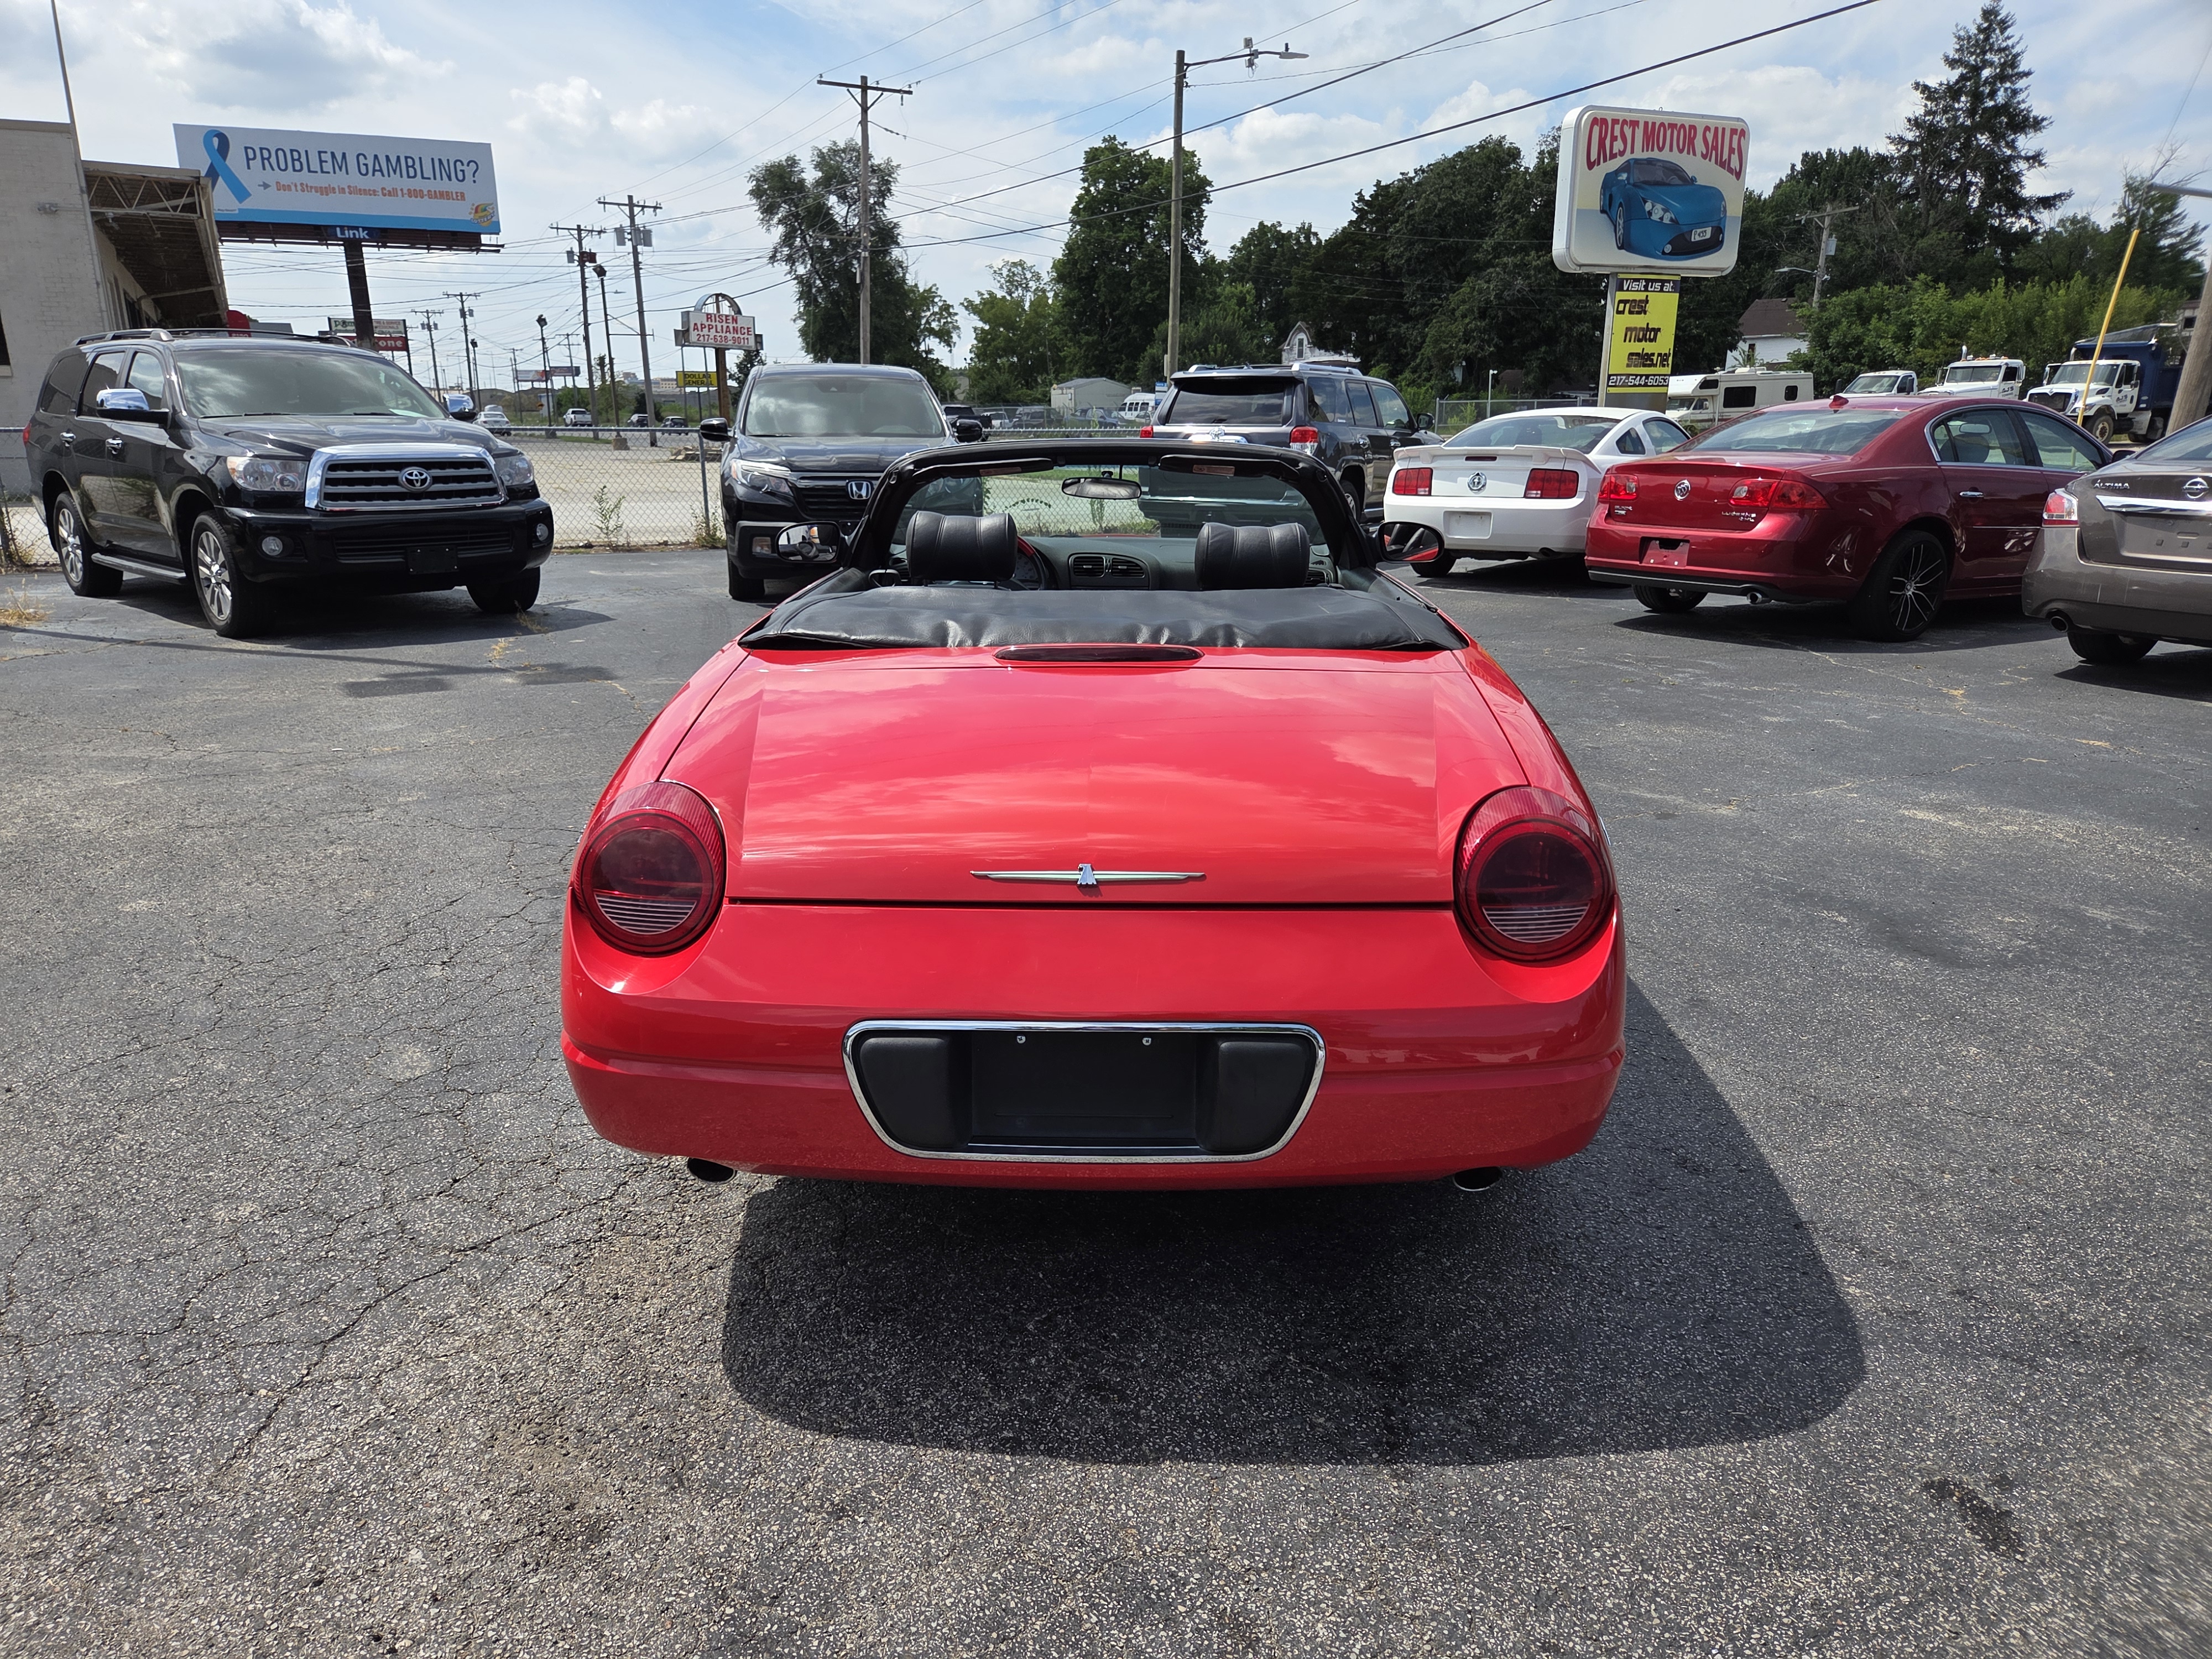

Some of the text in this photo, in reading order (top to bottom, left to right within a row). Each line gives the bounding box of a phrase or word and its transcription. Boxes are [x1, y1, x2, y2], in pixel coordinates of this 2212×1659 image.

[1586, 117, 1746, 181] CREST MOTOR SALES
[244, 146, 479, 184] PROBLEM GAMBLING?
[275, 181, 298, 192] Don't
[300, 182, 336, 196] Struggle
[348, 185, 380, 197] Silence:
[380, 187, 399, 197] Call
[400, 187, 466, 202] 1-800-GAMBLER
[336, 227, 371, 239] Link
[1623, 279, 1646, 291] Visit
[1648, 282, 1661, 291] us
[1615, 294, 1649, 315] crest
[706, 314, 738, 325] RISEN
[692, 322, 753, 336] APPLIANCE
[1623, 322, 1661, 343] motor
[696, 333, 749, 345] 217-638-9011
[1626, 347, 1671, 368] sales.net
[1608, 375, 1669, 385] 217-544-6053
